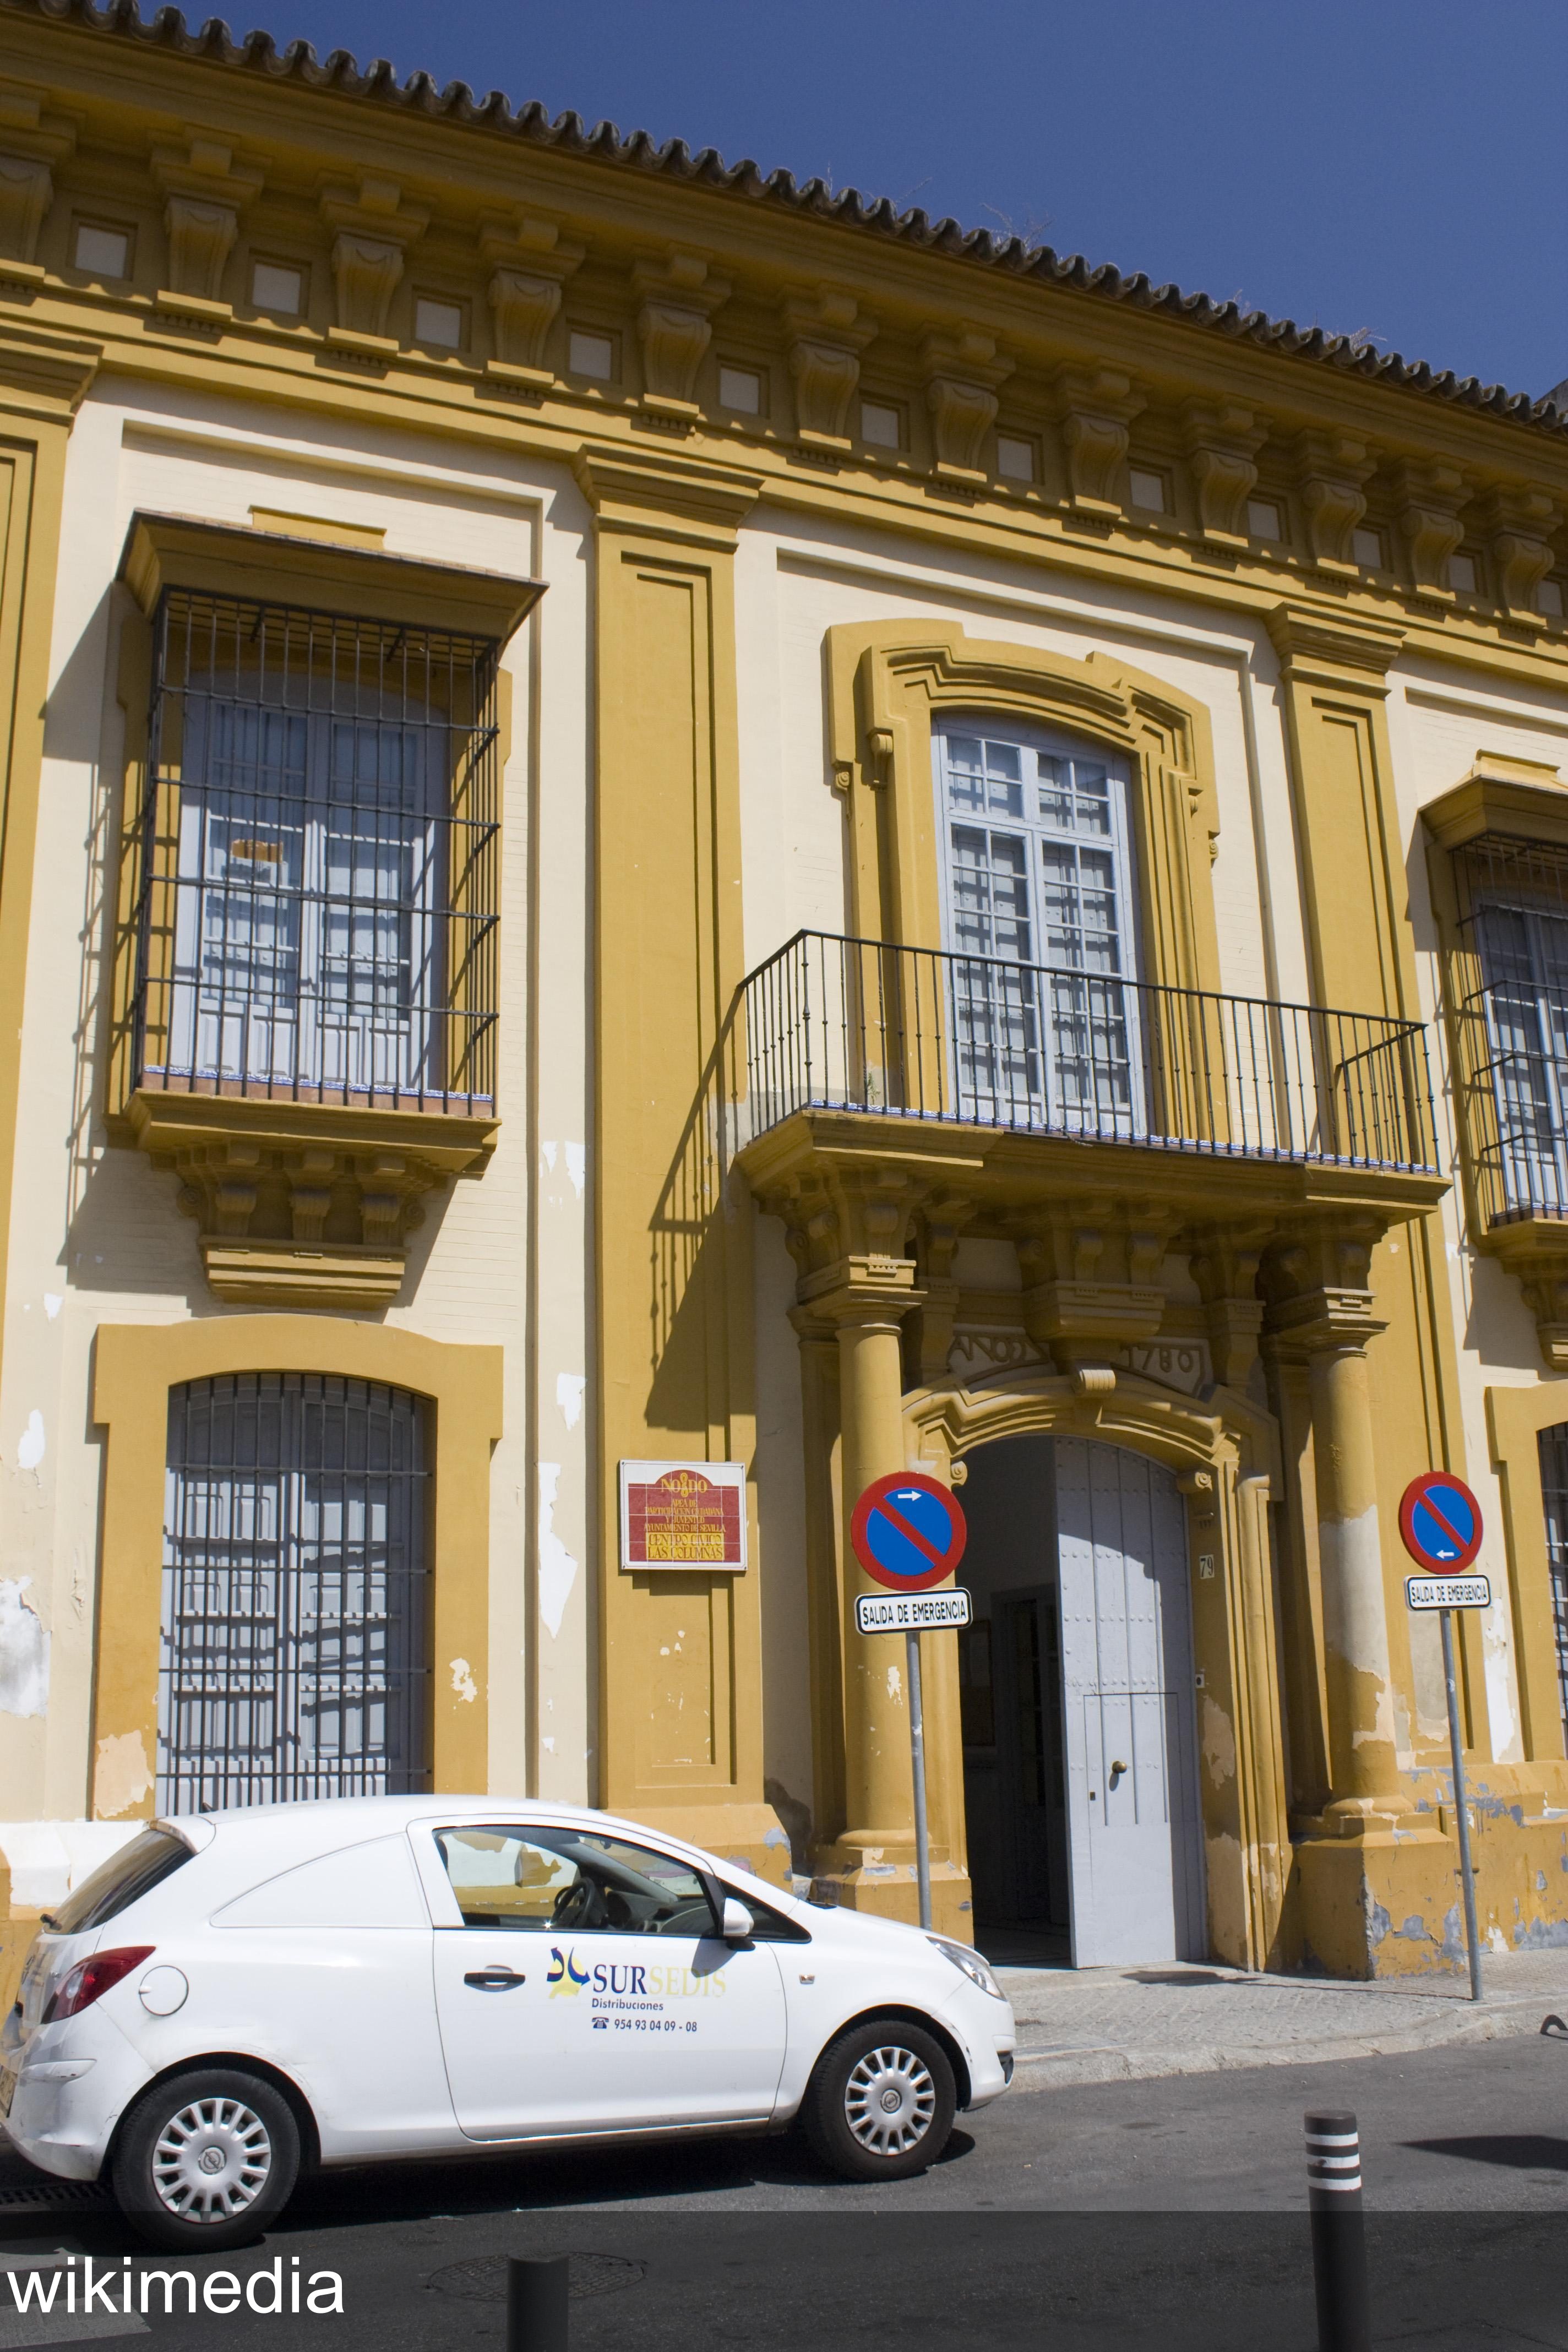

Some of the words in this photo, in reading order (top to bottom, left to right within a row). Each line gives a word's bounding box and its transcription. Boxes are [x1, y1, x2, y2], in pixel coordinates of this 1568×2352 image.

[1125, 1343, 1194, 1373] 1780
[644, 1523, 689, 1532] AYUNTAMIENTO
[648, 1546, 668, 1559] LAS
[671, 1547, 722, 1559] COLUMNAS
[1200, 1556, 1213, 1578] 79
[1412, 1587, 1434, 1602] SALIDA
[1436, 1586, 1445, 1601] DE
[1447, 1585, 1487, 1600] EMERGENCIA
[863, 1605, 894, 1625] SALIDA
[897, 1604, 908, 1623] DE
[912, 1601, 966, 1621] EMERGENCIA
[592, 1998, 663, 2010] Distribuciones
[614, 2019, 631, 2029] 954
[635, 2020, 646, 2030] 93
[650, 2021, 660, 2030] 04
[664, 2021, 675, 2031] 09
[685, 2022, 697, 2032] 08
